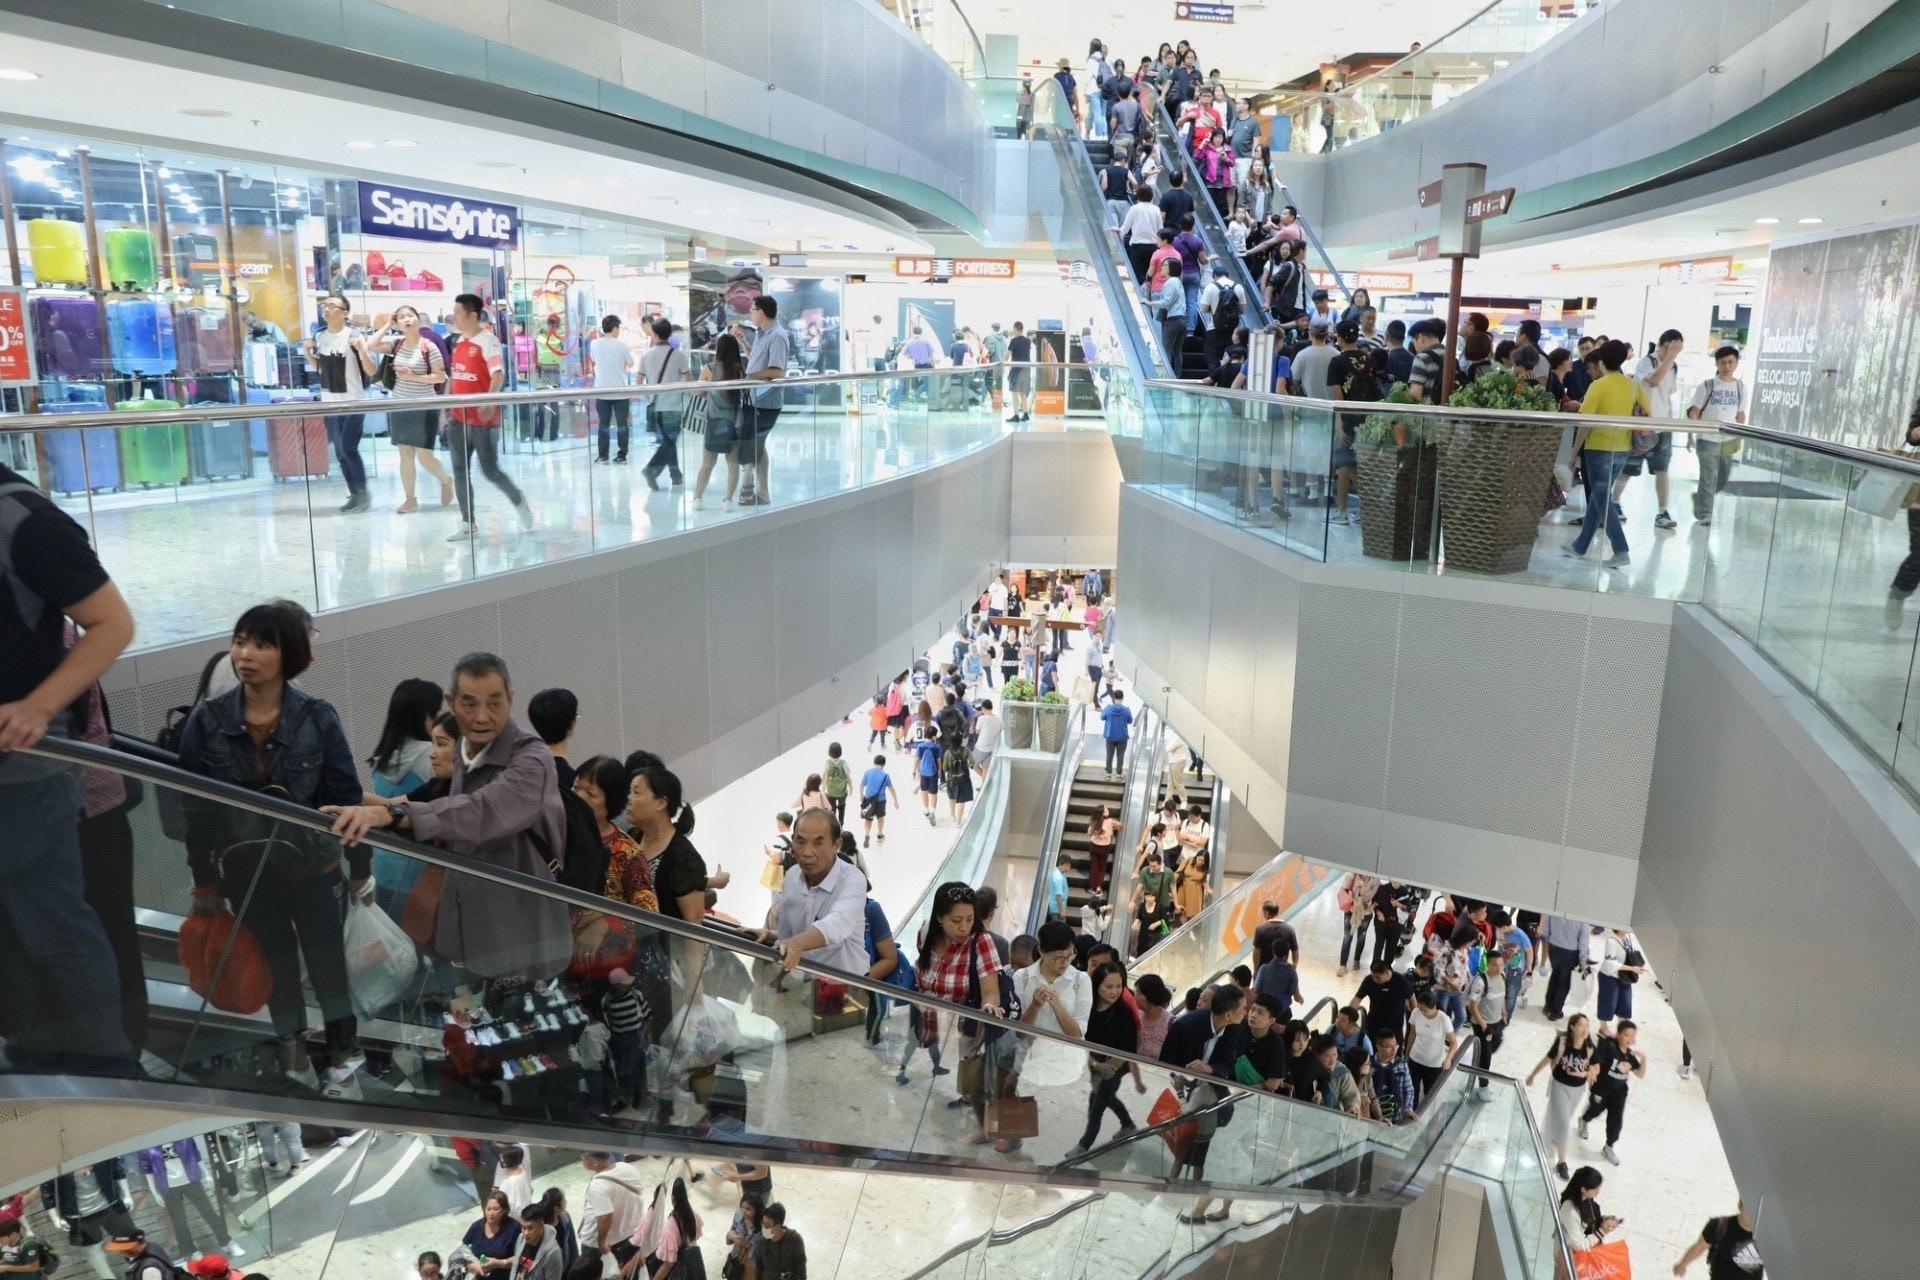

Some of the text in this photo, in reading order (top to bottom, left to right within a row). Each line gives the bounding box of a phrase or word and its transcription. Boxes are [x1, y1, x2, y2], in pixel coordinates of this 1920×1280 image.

[371, 190, 511, 240] Samsonite
[955, 261, 1011, 276] FORTRESS
[1762, 327, 1807, 353] Timberland
[1757, 369, 1812, 387] RELOCATED TO
[1761, 388, 1781, 404] SHOP
